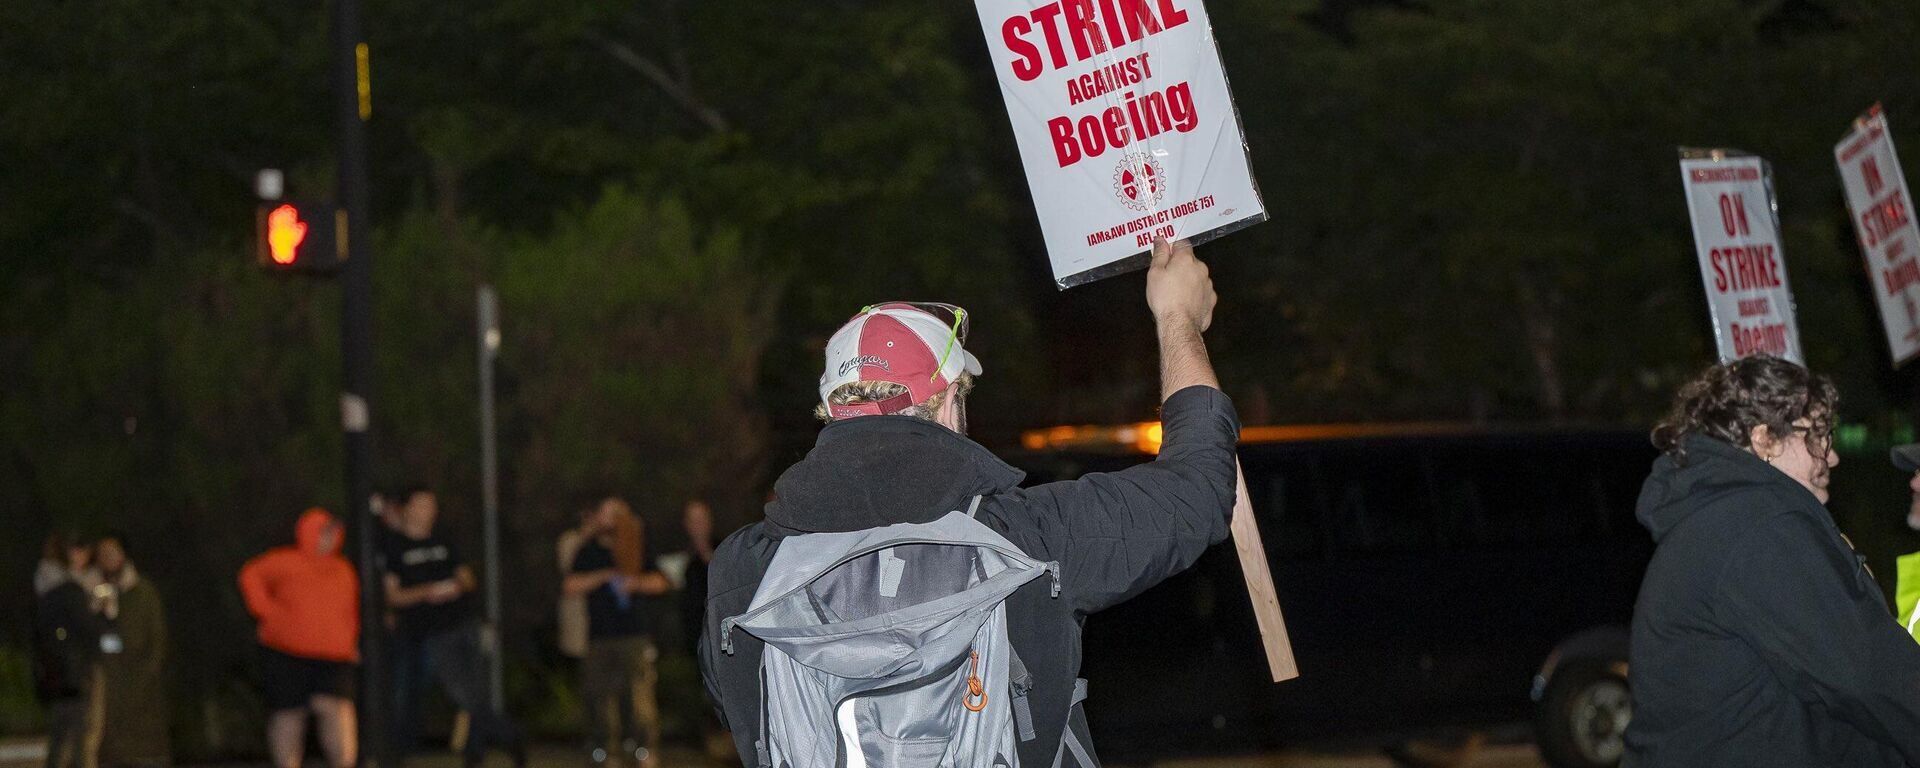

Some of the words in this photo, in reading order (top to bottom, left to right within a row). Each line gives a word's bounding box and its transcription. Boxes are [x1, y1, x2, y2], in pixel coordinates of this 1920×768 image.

[1067, 52, 1152, 106] AGAINST
[1048, 81, 1198, 168] Boeing
[1087, 224, 1126, 247] IAM&AW
[1127, 210, 1170, 233] DISTRICT
[1170, 200, 1199, 219] LODGE
[1198, 194, 1215, 210] 751
[1719, 193, 1750, 238] ON
[1709, 245, 1781, 293] STRIKE
